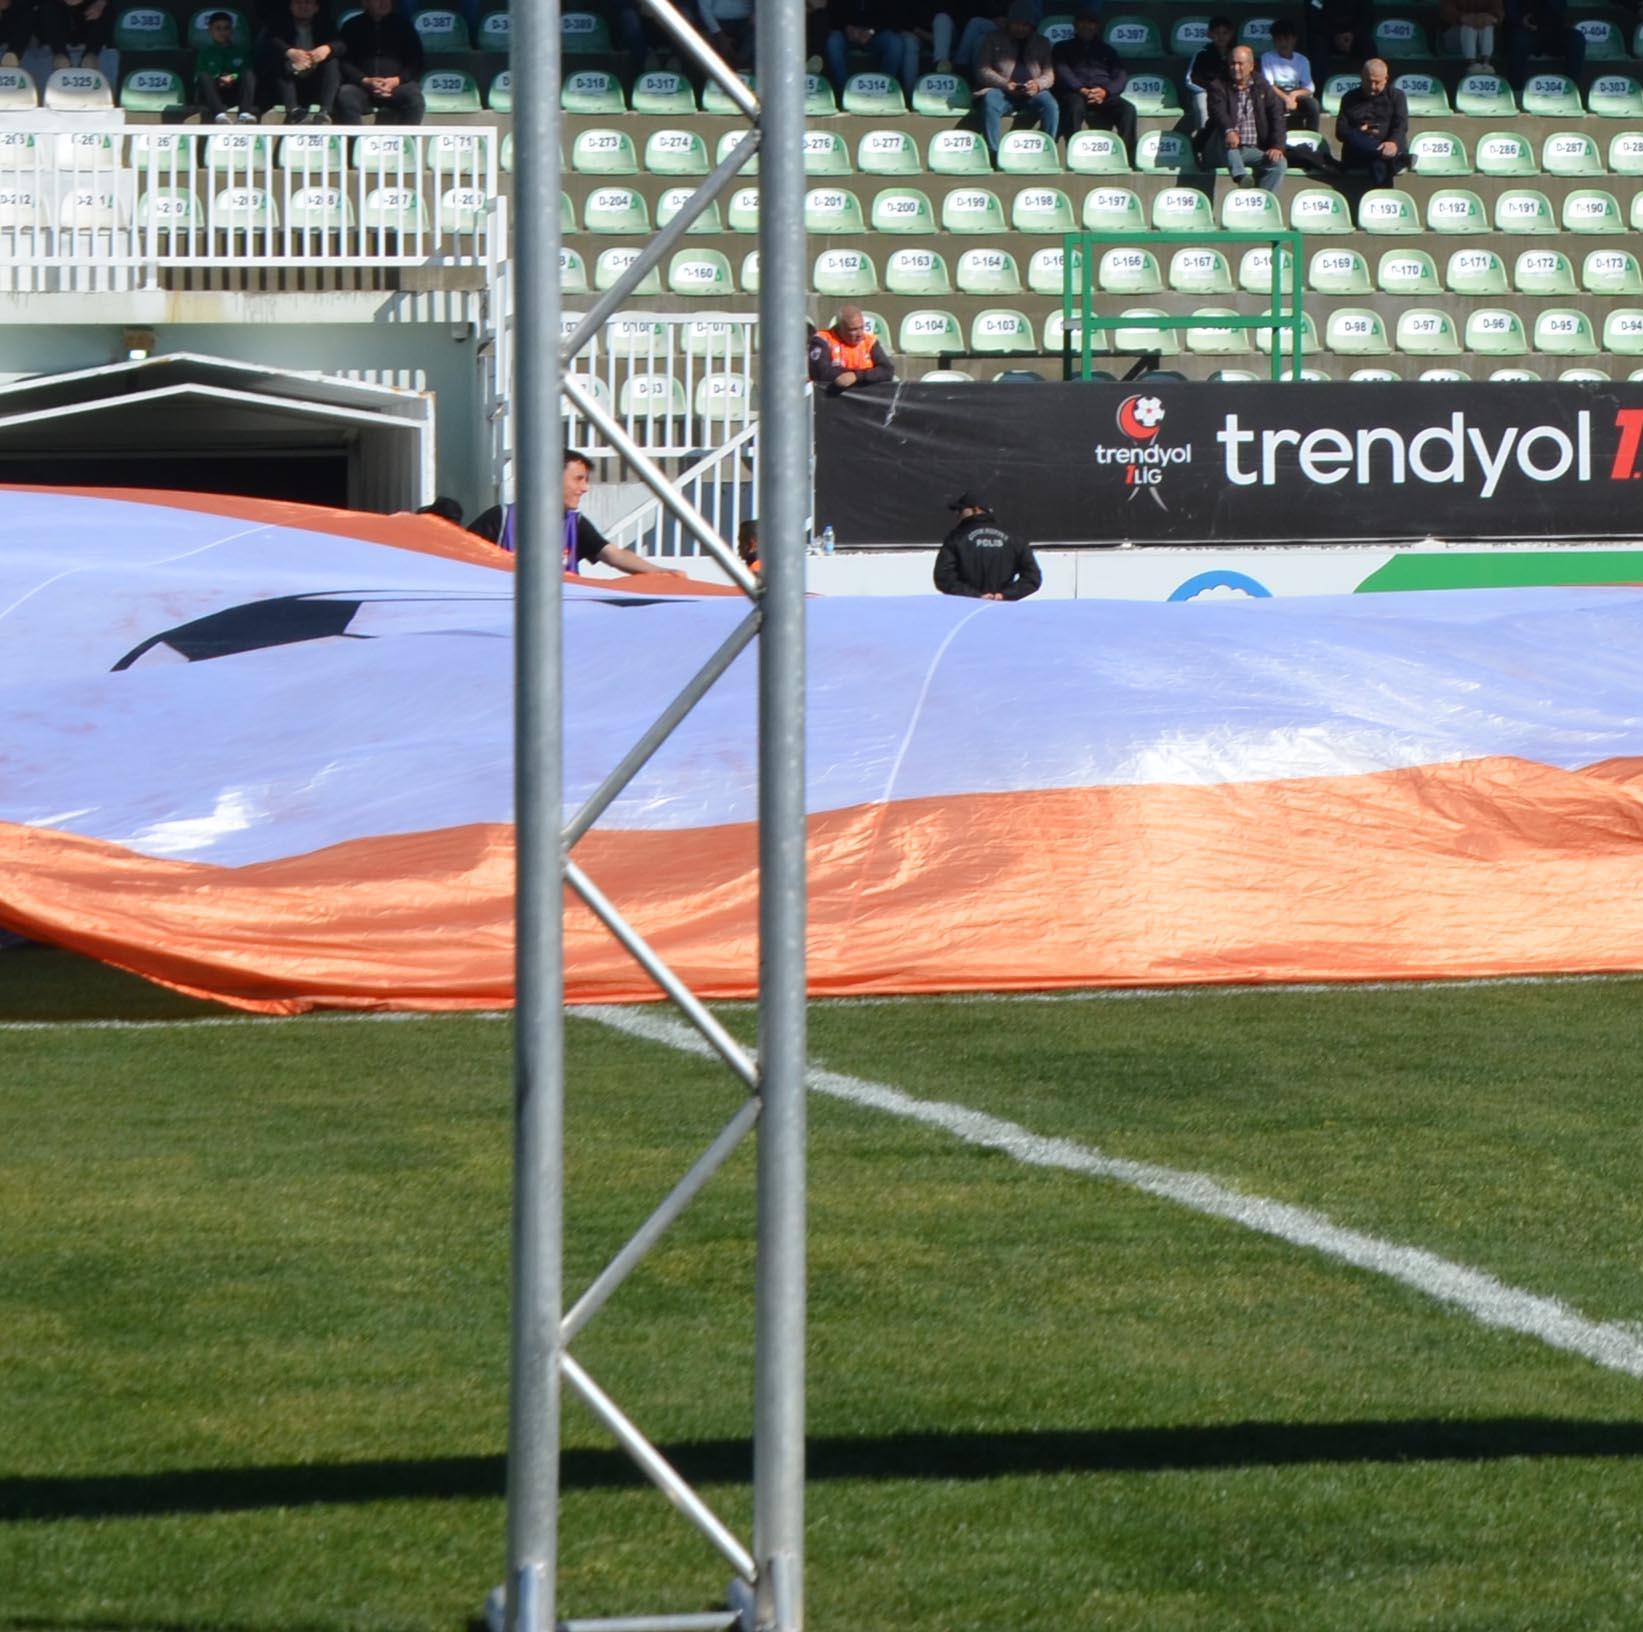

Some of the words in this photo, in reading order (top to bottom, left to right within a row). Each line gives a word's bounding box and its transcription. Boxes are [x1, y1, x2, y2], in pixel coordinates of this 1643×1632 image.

[1468, 80, 1498, 92] D-305
[1534, 81, 1563, 93] D-304
[1599, 81, 1627, 93] D-303
[587, 138, 617, 149] D-273
[659, 137, 689, 148] D-274
[871, 137, 900, 149] D-277
[1422, 143, 1449, 154] D-285
[598, 196, 628, 207] D-204
[956, 197, 986, 208] D-199
[1024, 196, 1053, 207] D-198
[1438, 203, 1466, 214] D-192
[828, 257, 858, 269] D-162
[900, 256, 930, 267] D-163
[1322, 258, 1351, 269] D-169
[1459, 257, 1487, 268] D-171
[1526, 258, 1554, 269] D-172
[1595, 258, 1623, 269] D-173
[914, 320, 944, 331] D-104
[1344, 322, 1367, 333] D-98
[1412, 320, 1434, 331] D-97
[1482, 318, 1505, 329] D-96
[1550, 320, 1573, 331] D-95
[1620, 321, 1643, 332] D-94
[1095, 443, 1192, 468] trendyol
[1216, 410, 1591, 499] trendyol
